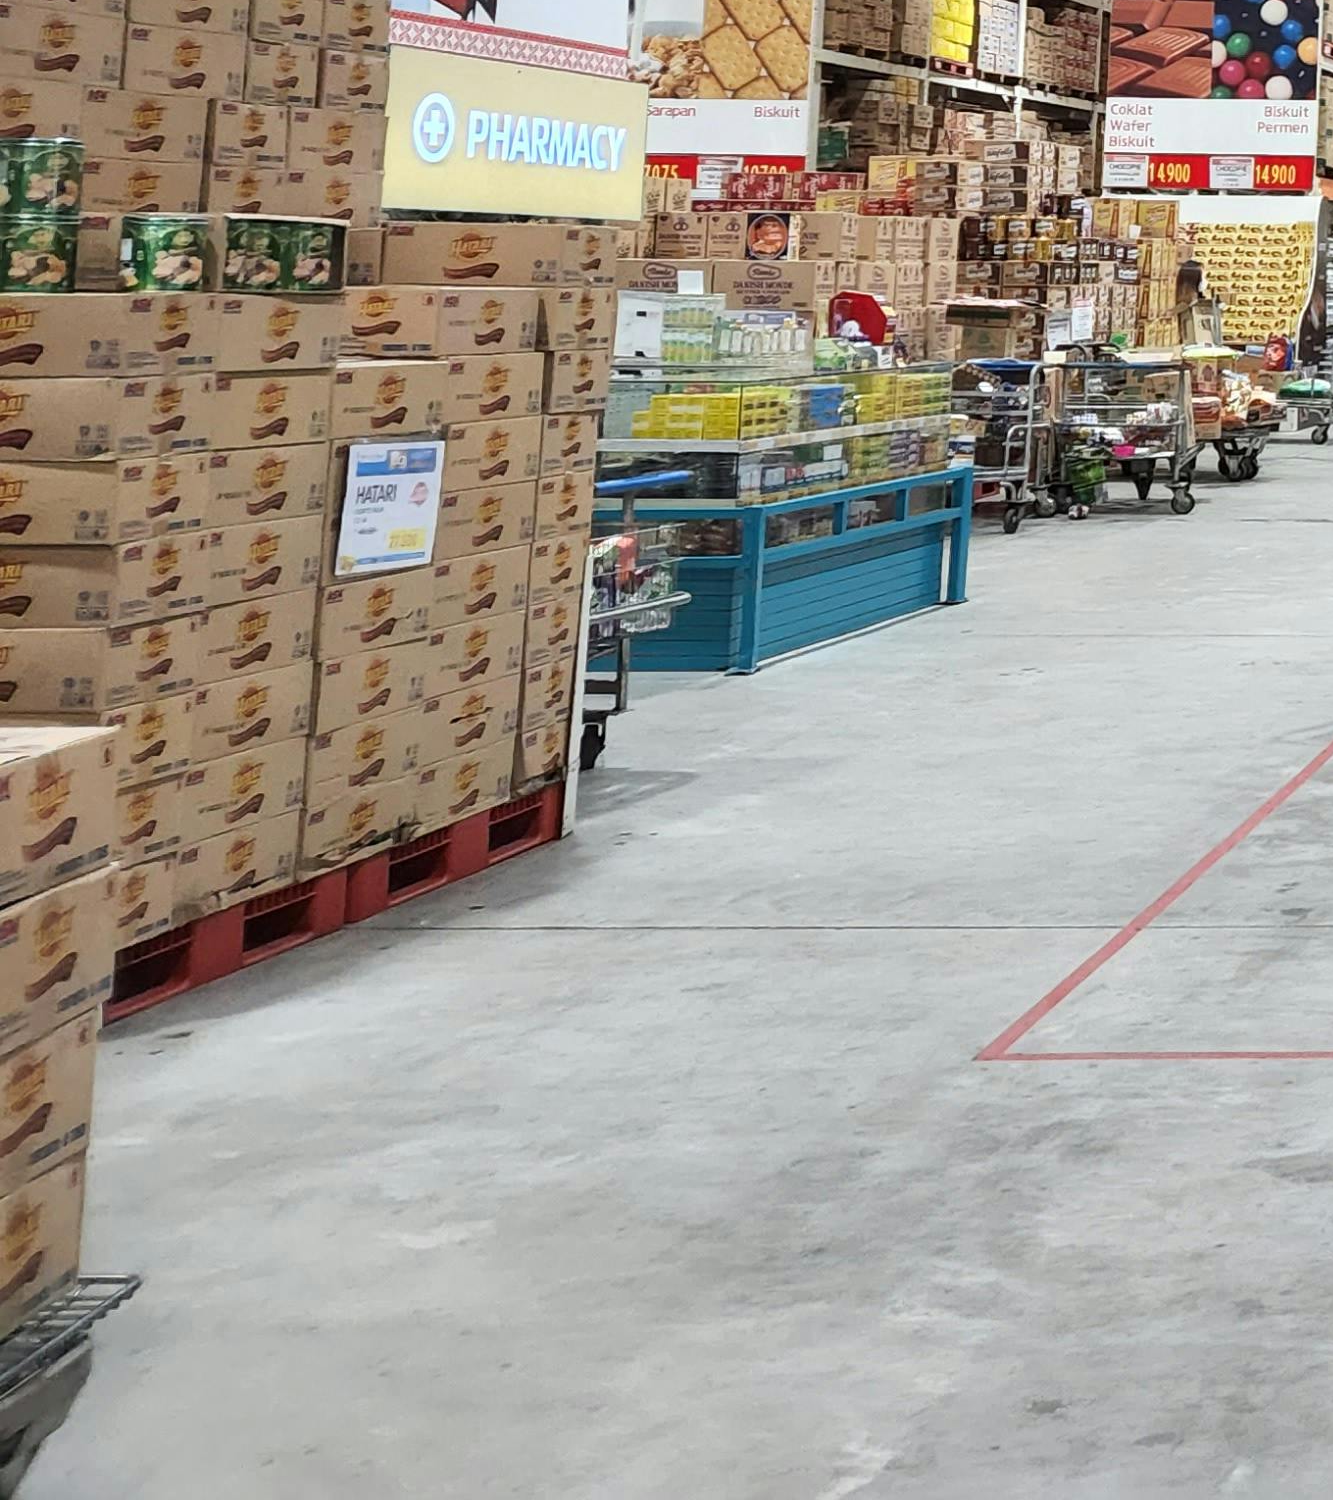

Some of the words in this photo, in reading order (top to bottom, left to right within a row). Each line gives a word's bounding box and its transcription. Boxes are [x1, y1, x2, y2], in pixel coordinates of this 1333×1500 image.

[754, 106, 800, 118] Biskuit
[1111, 103, 1153, 116] Coklat
[1264, 105, 1309, 118] Biskuit
[1110, 120, 1152, 132] Wafer
[1257, 121, 1309, 134] Permen
[465, 109, 627, 173] PHARMACY
[1108, 135, 1155, 147] Biskuit
[1149, 163, 1190, 183] 14900
[1255, 164, 1296, 185] 14900
[355, 483, 398, 504] HATARI
